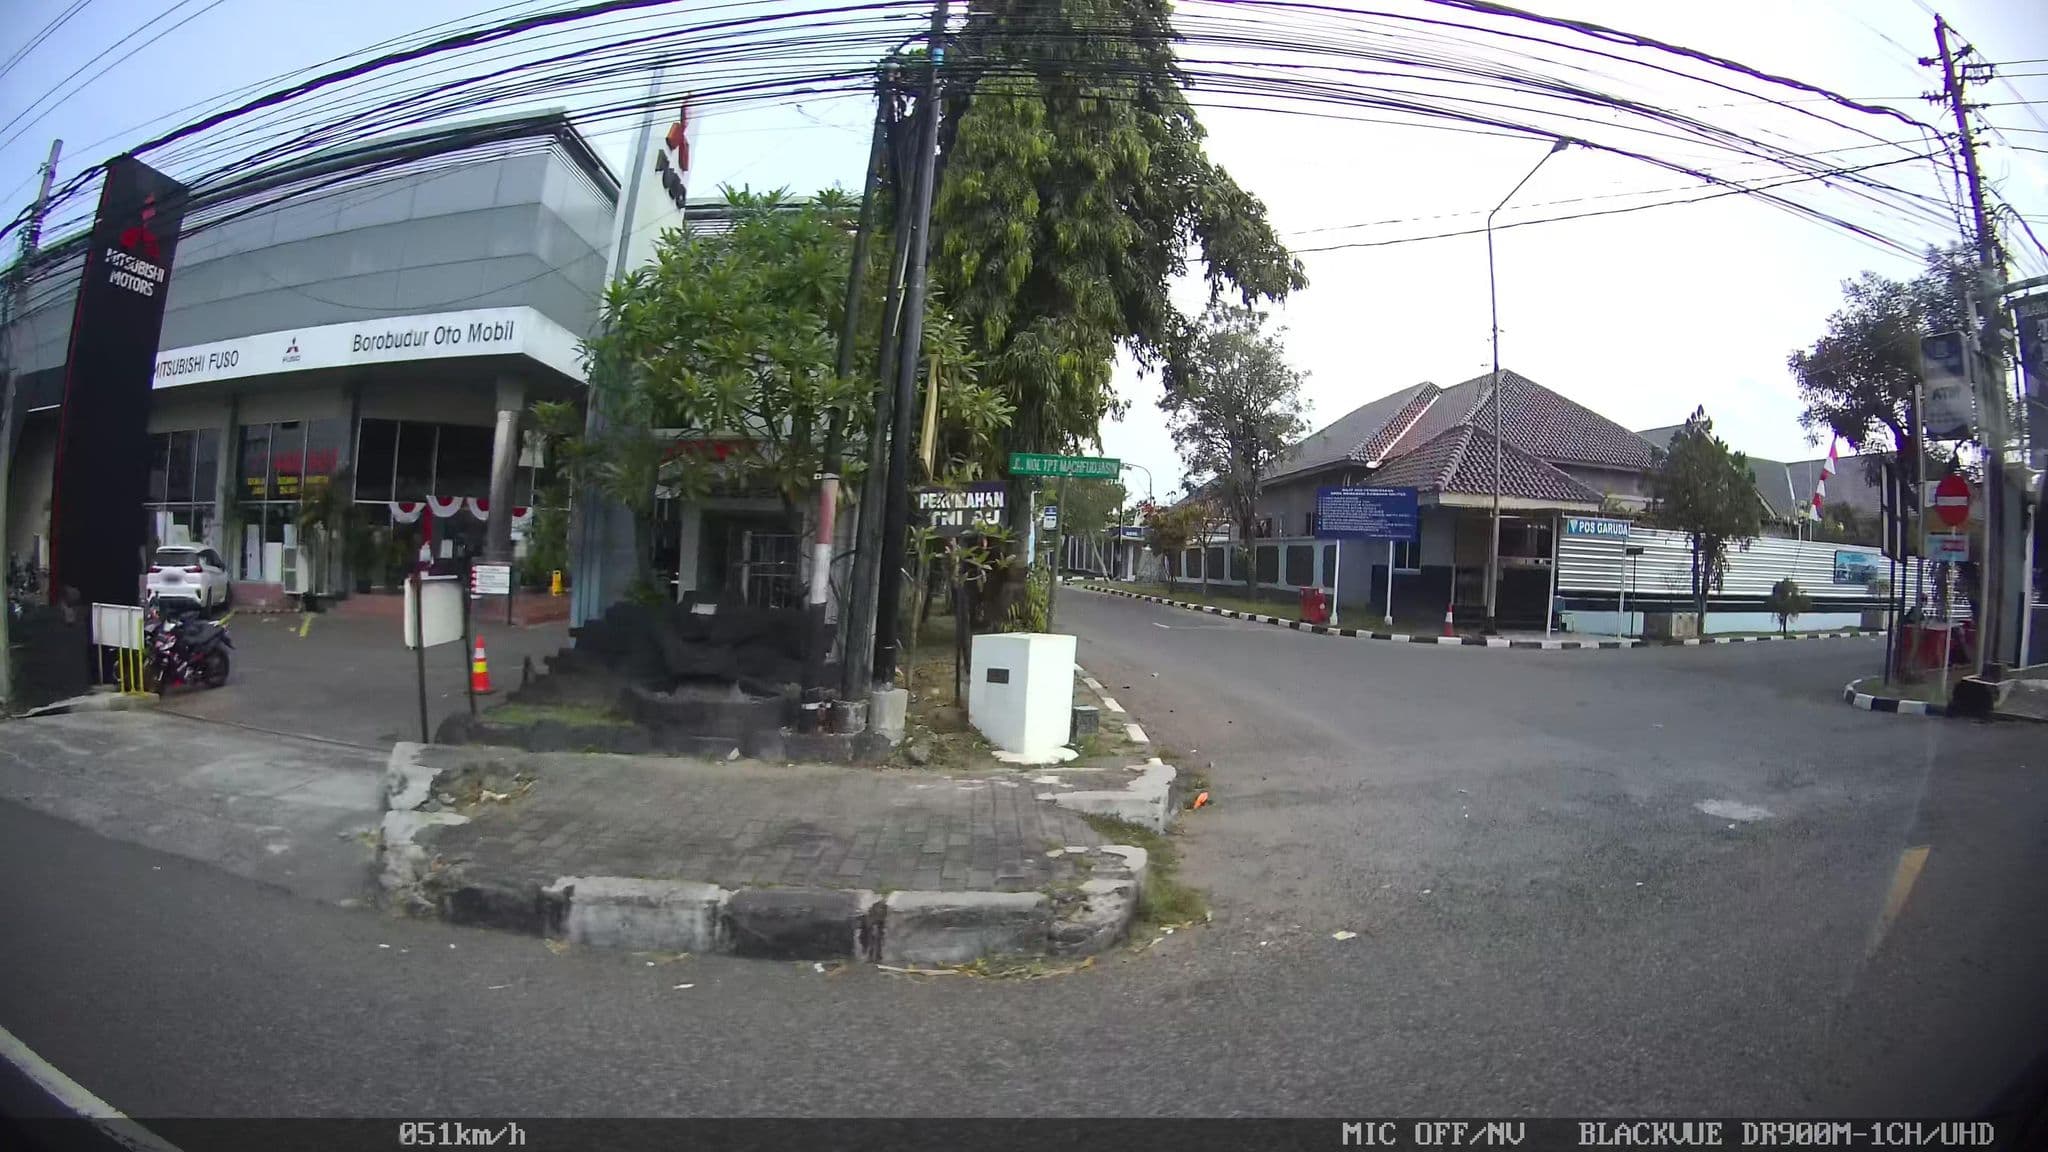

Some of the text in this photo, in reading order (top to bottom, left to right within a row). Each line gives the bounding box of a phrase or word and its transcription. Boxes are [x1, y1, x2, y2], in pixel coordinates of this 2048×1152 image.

[104, 247, 165, 283] MITSUBISHI
[109, 270, 155, 297] MOTORS
[352, 320, 515, 353] Borobudur Oto Mobil
[208, 350, 240, 371] FUSO
[1579, 520, 1628, 537] POS GARUDA
